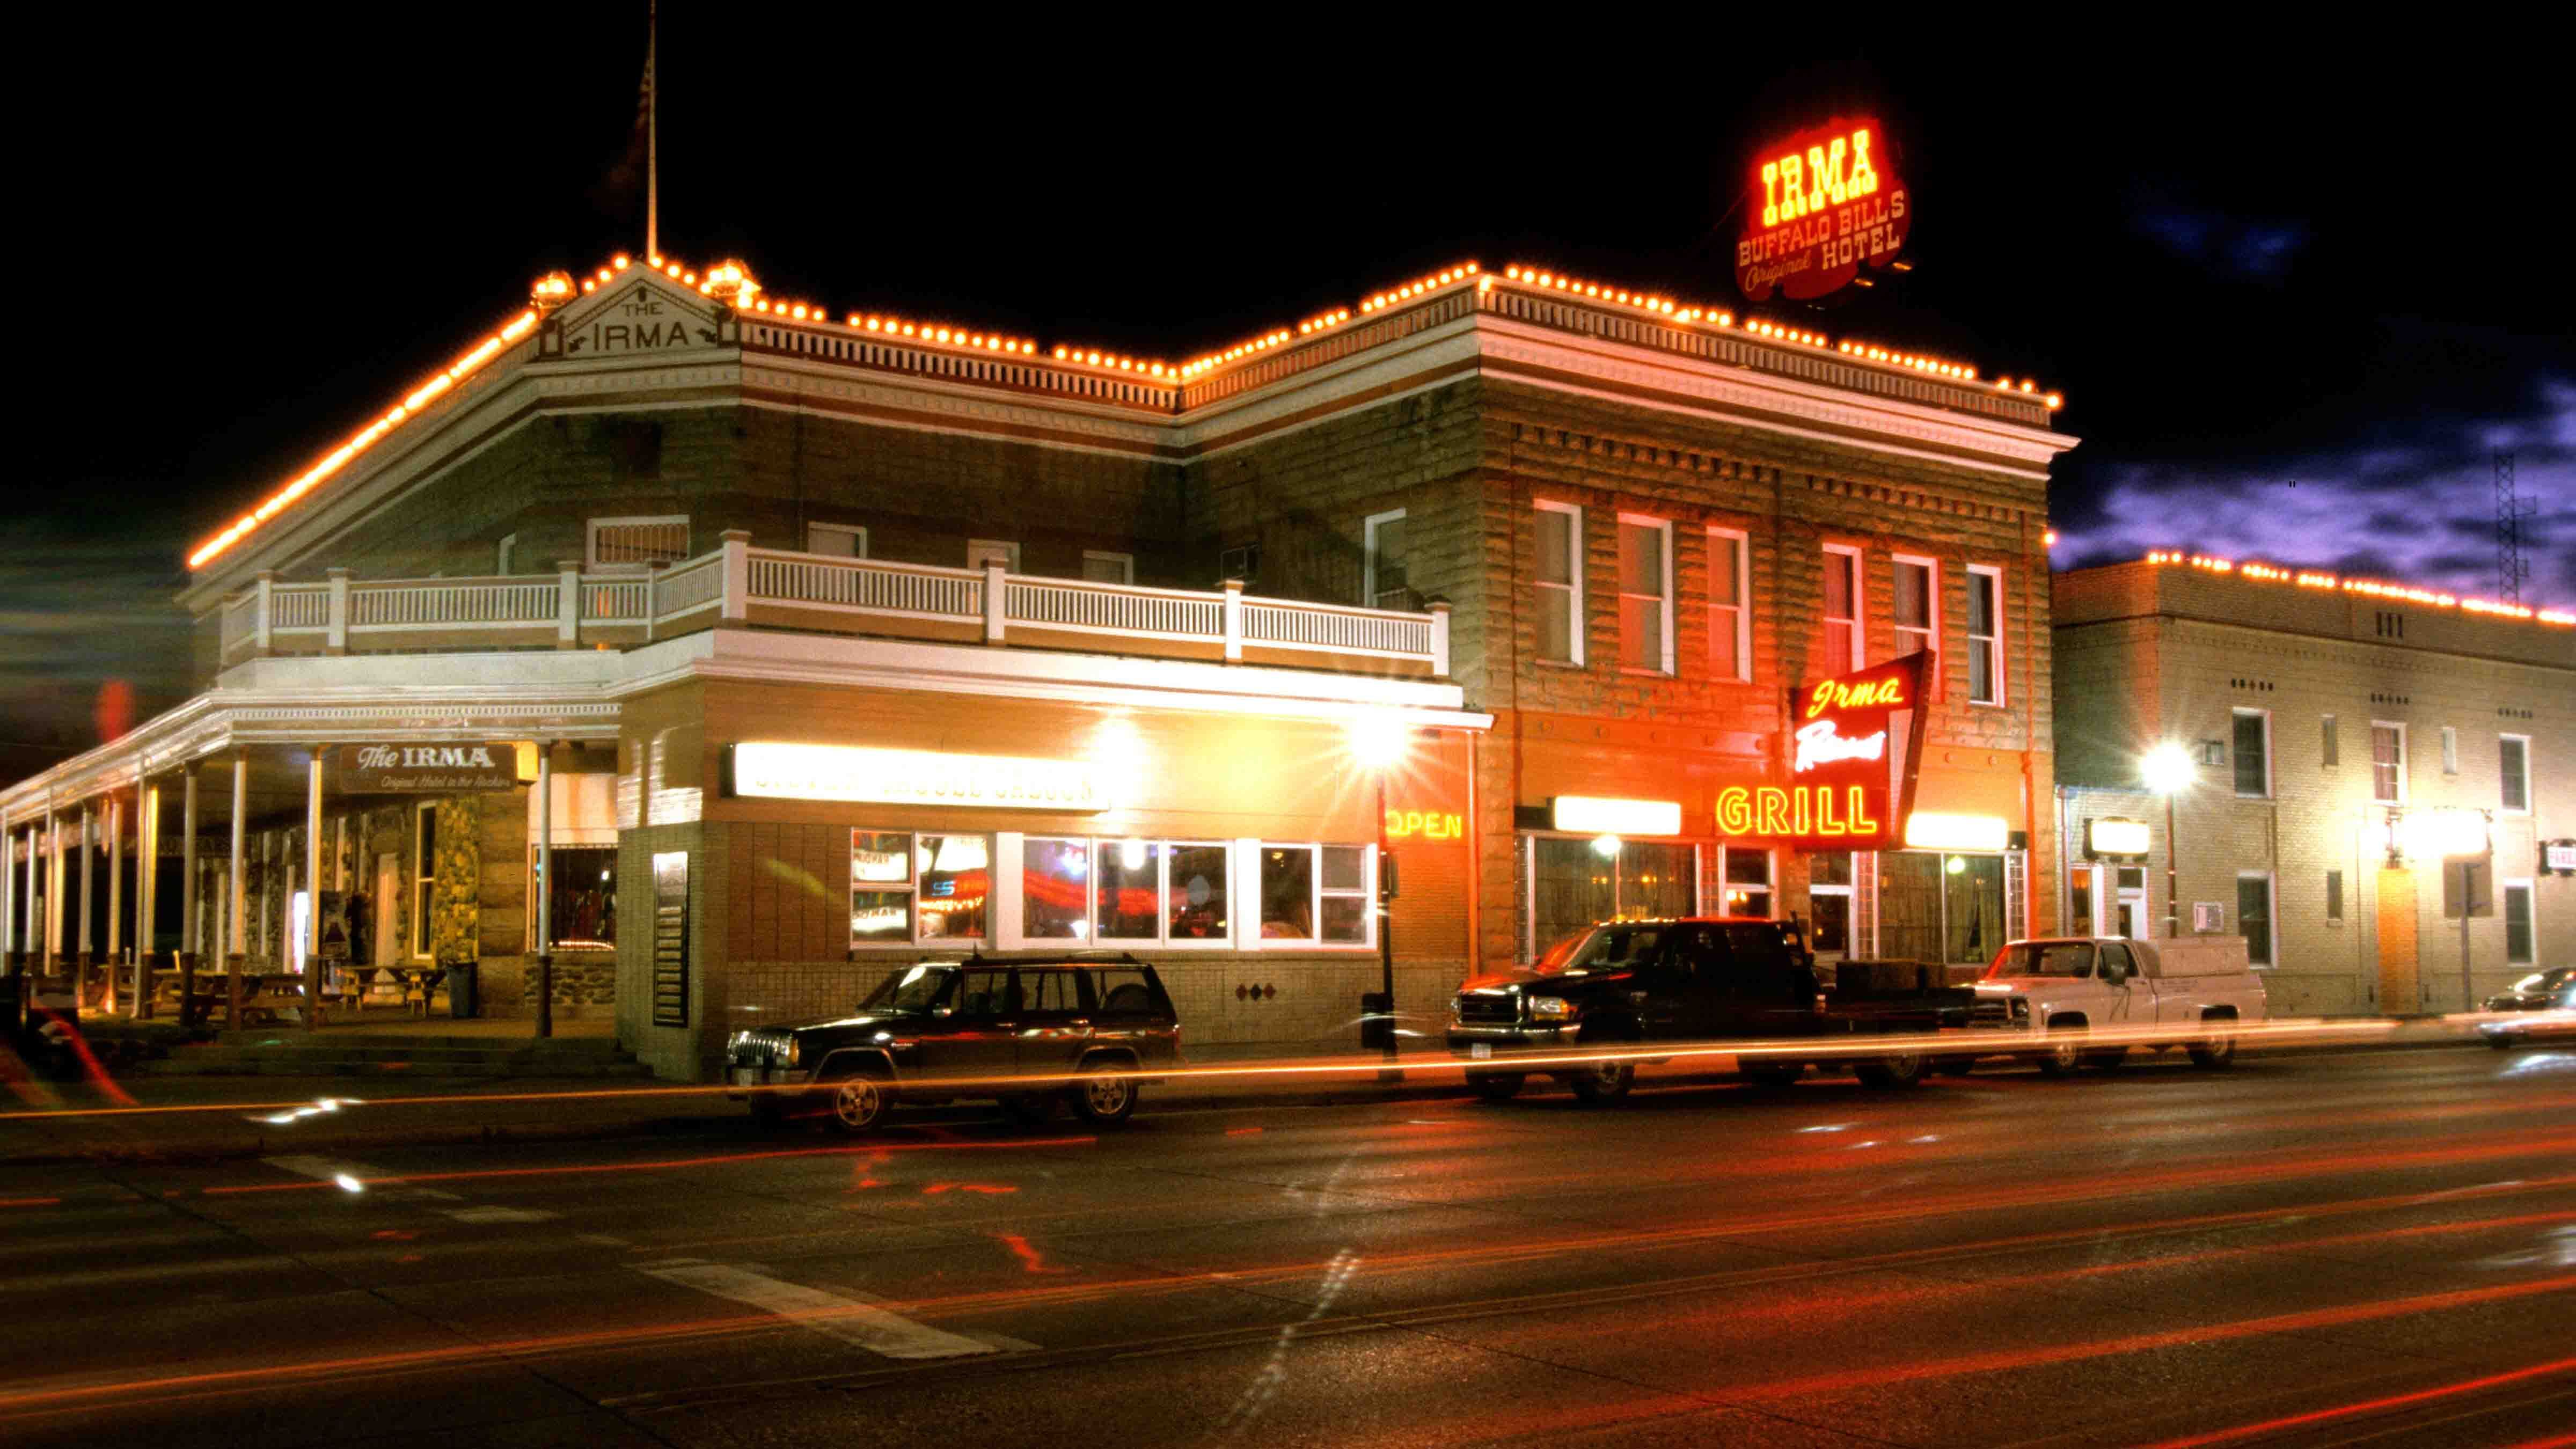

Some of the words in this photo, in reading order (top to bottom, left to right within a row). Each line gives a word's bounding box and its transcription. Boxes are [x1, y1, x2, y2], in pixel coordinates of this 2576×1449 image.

[1762, 129, 1877, 227] IRMA
[1738, 215, 1831, 267] BUFFALO
[1745, 249, 1812, 292] Original
[1821, 223, 1900, 270] HOTEL
[622, 301, 663, 317] THE
[593, 321, 689, 351] IRMA
[1806, 677, 1904, 718] Irma
[357, 744, 399, 769] The
[402, 747, 495, 768] IRMA
[1385, 809, 1462, 838] OPEN
[1716, 786, 1877, 835] GRILL
